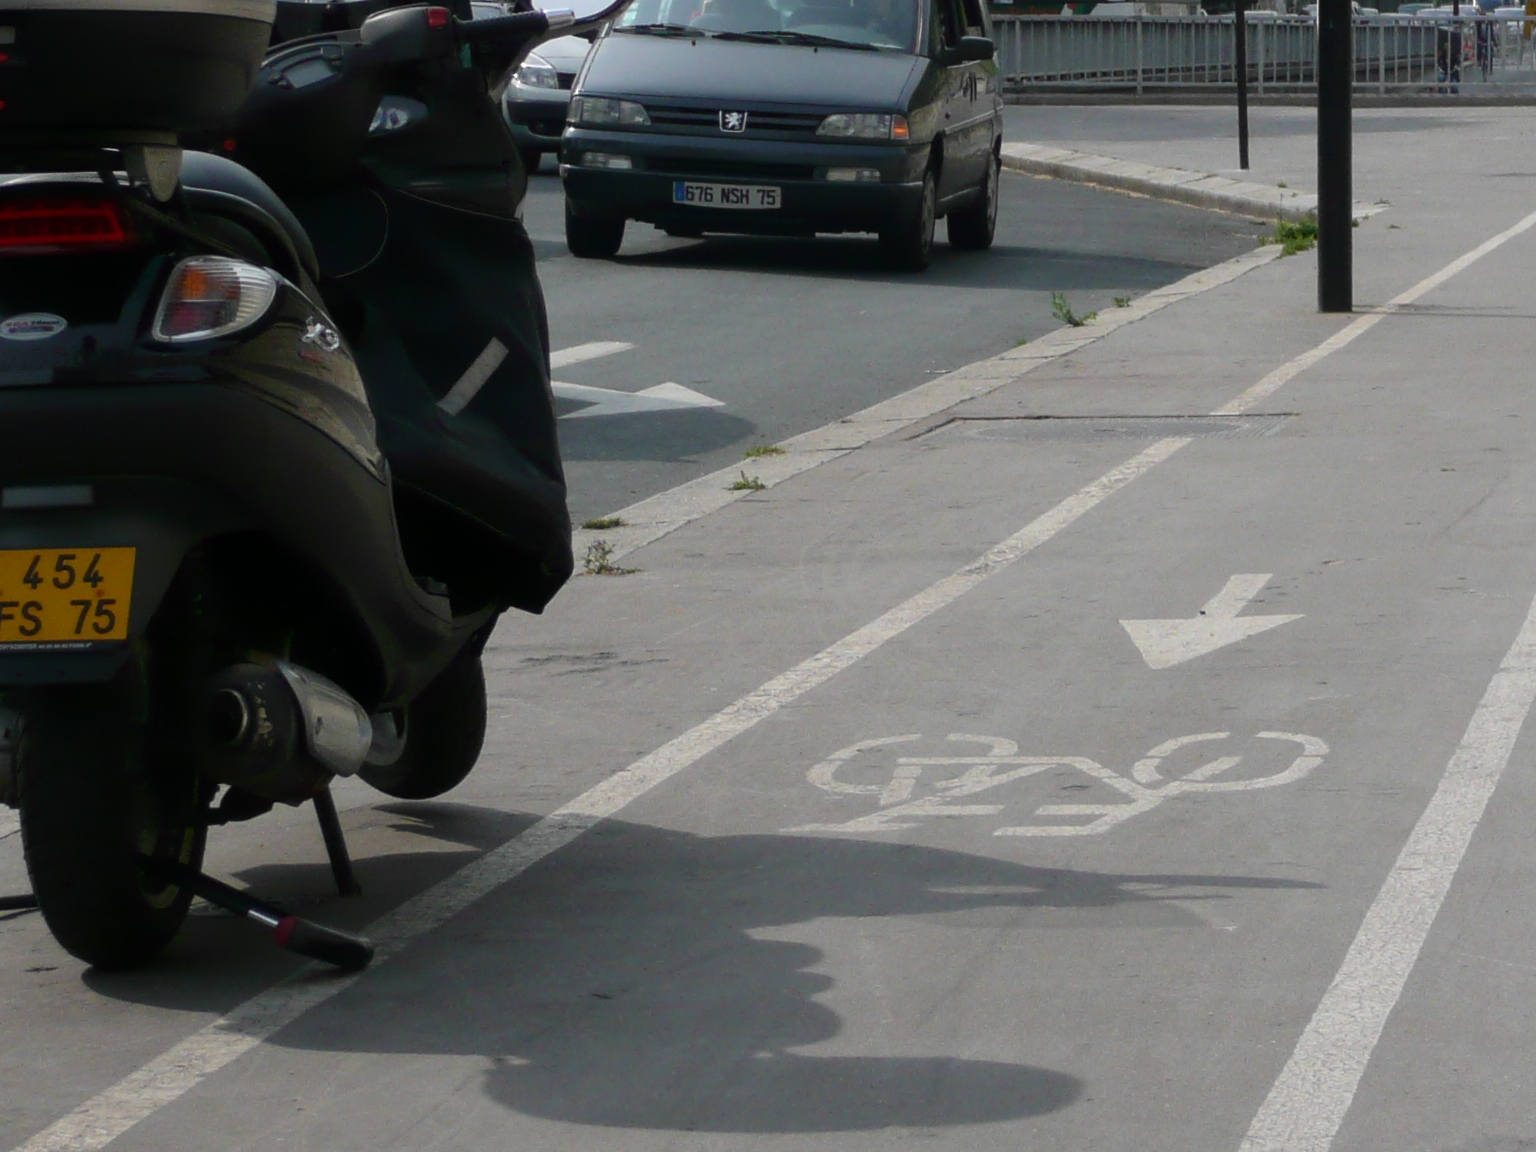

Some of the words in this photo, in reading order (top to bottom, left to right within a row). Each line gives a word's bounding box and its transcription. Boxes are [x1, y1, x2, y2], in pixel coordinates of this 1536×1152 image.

[685, 185, 714, 203] 676
[720, 187, 750, 205] NSH
[756, 189, 777, 206] 75
[23, 553, 105, 590] 454
[0, 600, 43, 637] FS
[70, 598, 117, 635] 75
